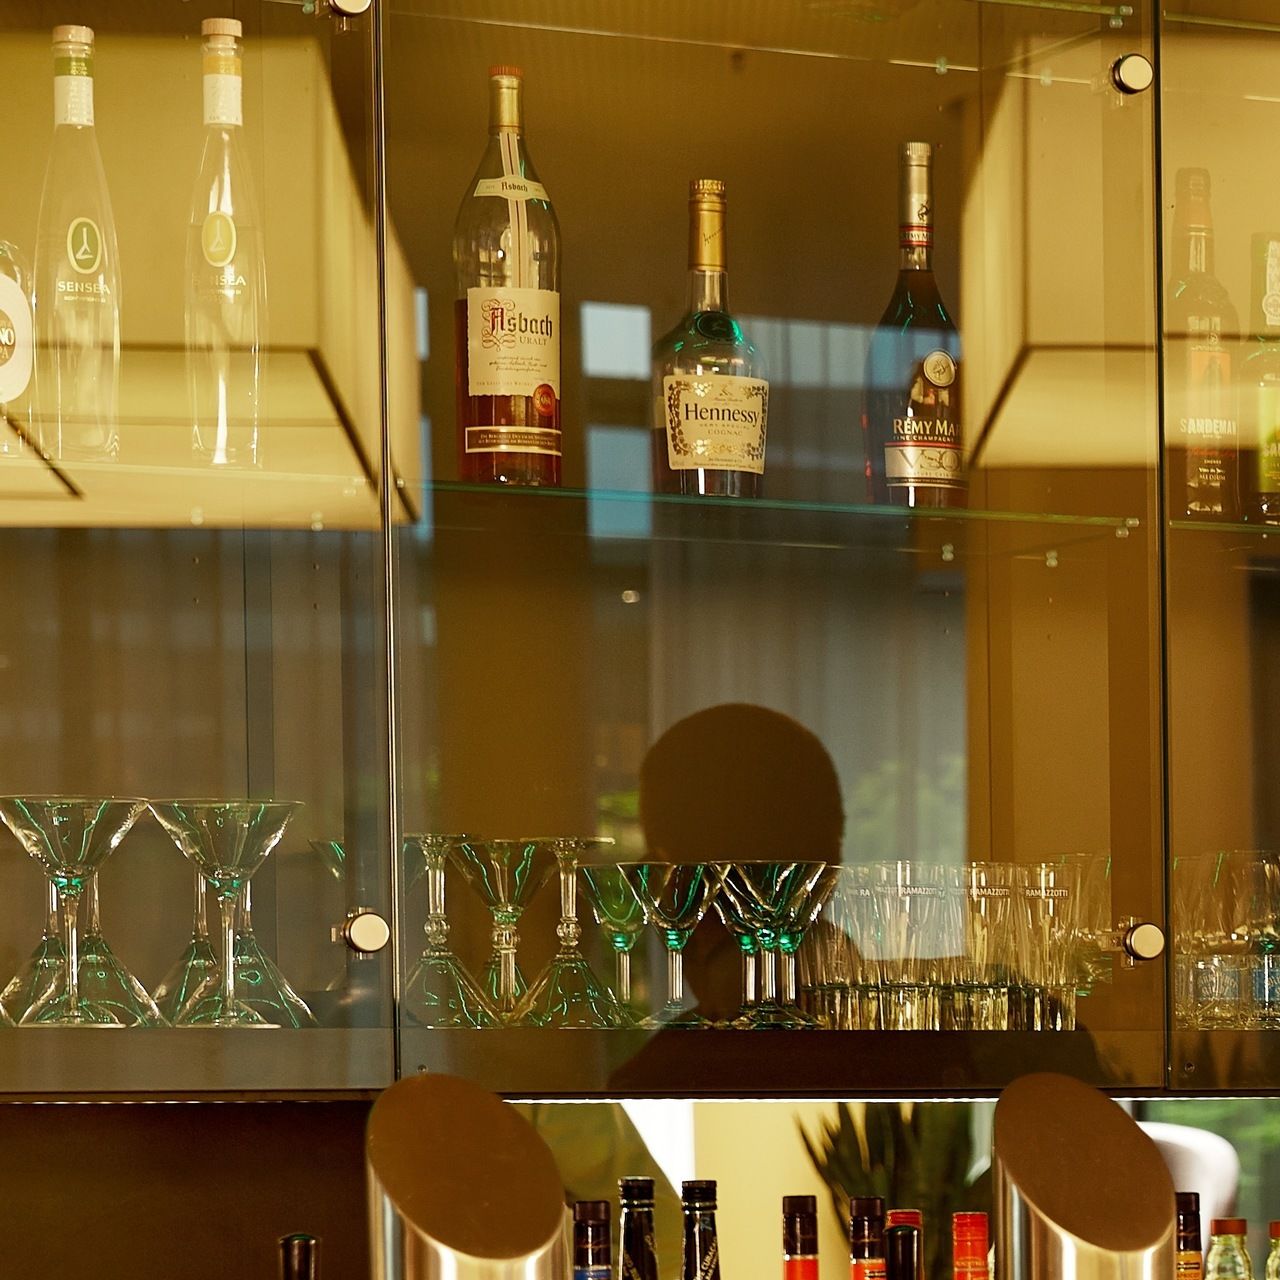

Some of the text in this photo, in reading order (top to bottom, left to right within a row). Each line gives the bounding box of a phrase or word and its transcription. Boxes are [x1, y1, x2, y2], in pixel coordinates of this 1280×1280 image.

[501, 181, 528, 193] Asbach
[57, 280, 111, 295] SENSEA
[487, 305, 553, 340] Asbach
[519, 337, 547, 347] URALT
[684, 402, 760, 428] Hennessy
[707, 428, 743, 437] COGNAC
[893, 417, 932, 435] RÉMY
[1180, 417, 1237, 435] SANDEMAN
